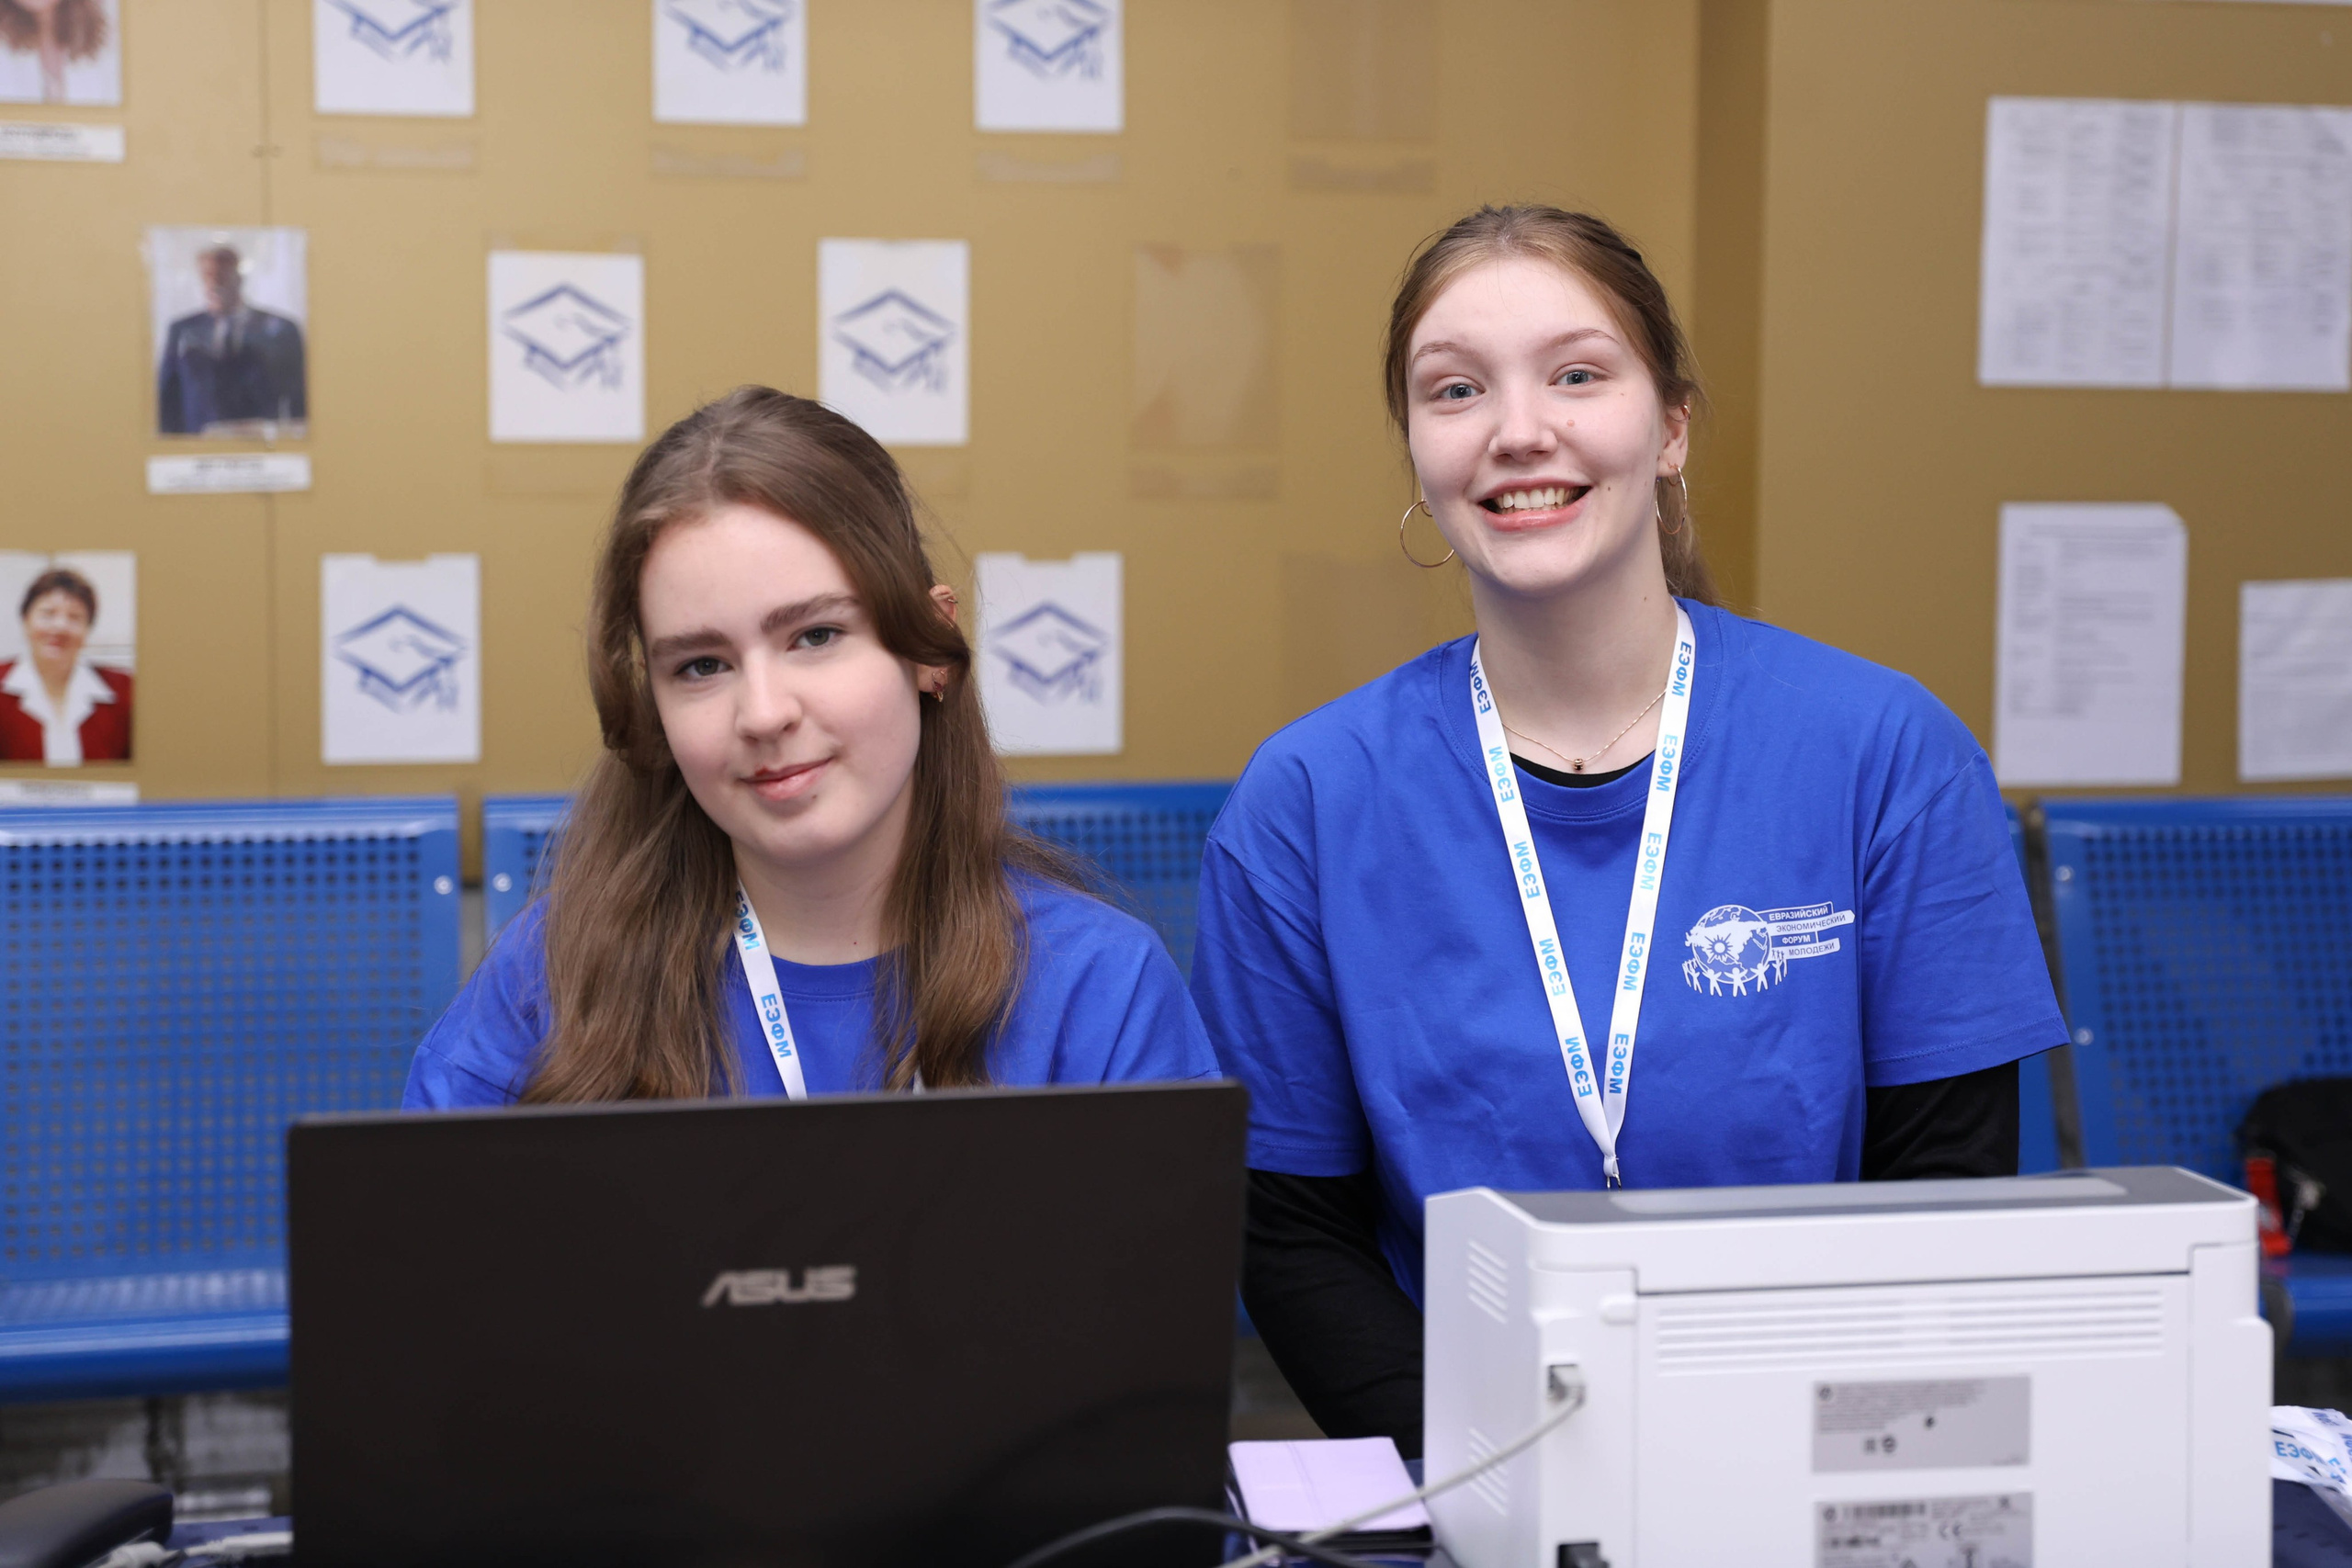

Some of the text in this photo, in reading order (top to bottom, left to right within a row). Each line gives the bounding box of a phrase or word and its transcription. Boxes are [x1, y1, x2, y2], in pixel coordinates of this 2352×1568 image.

[1488, 746, 1515, 803] ЕЭФМ
[1513, 840, 1541, 899] ЕЭФМ
[1609, 641, 1692, 1094] ЕЭФМ ЕЭФМ ЕЭФМ ЕЭФМ ЕЭФМ
[1769, 906, 1828, 921] ЕВРАЗИЙСКИЙ
[1776, 913, 1846, 933] ЭКОНОМИЧЕСКИЙ
[1781, 934, 1811, 944] ФОРУМ
[1539, 938, 1566, 997] ЕЭФМ
[1789, 942, 1835, 956] МОЛОДЕЖИ
[761, 993, 792, 1057] ЕЭФМ
[1565, 1036, 1593, 1098] ЕЭФМ
[701, 1266, 856, 1307] ASUS
